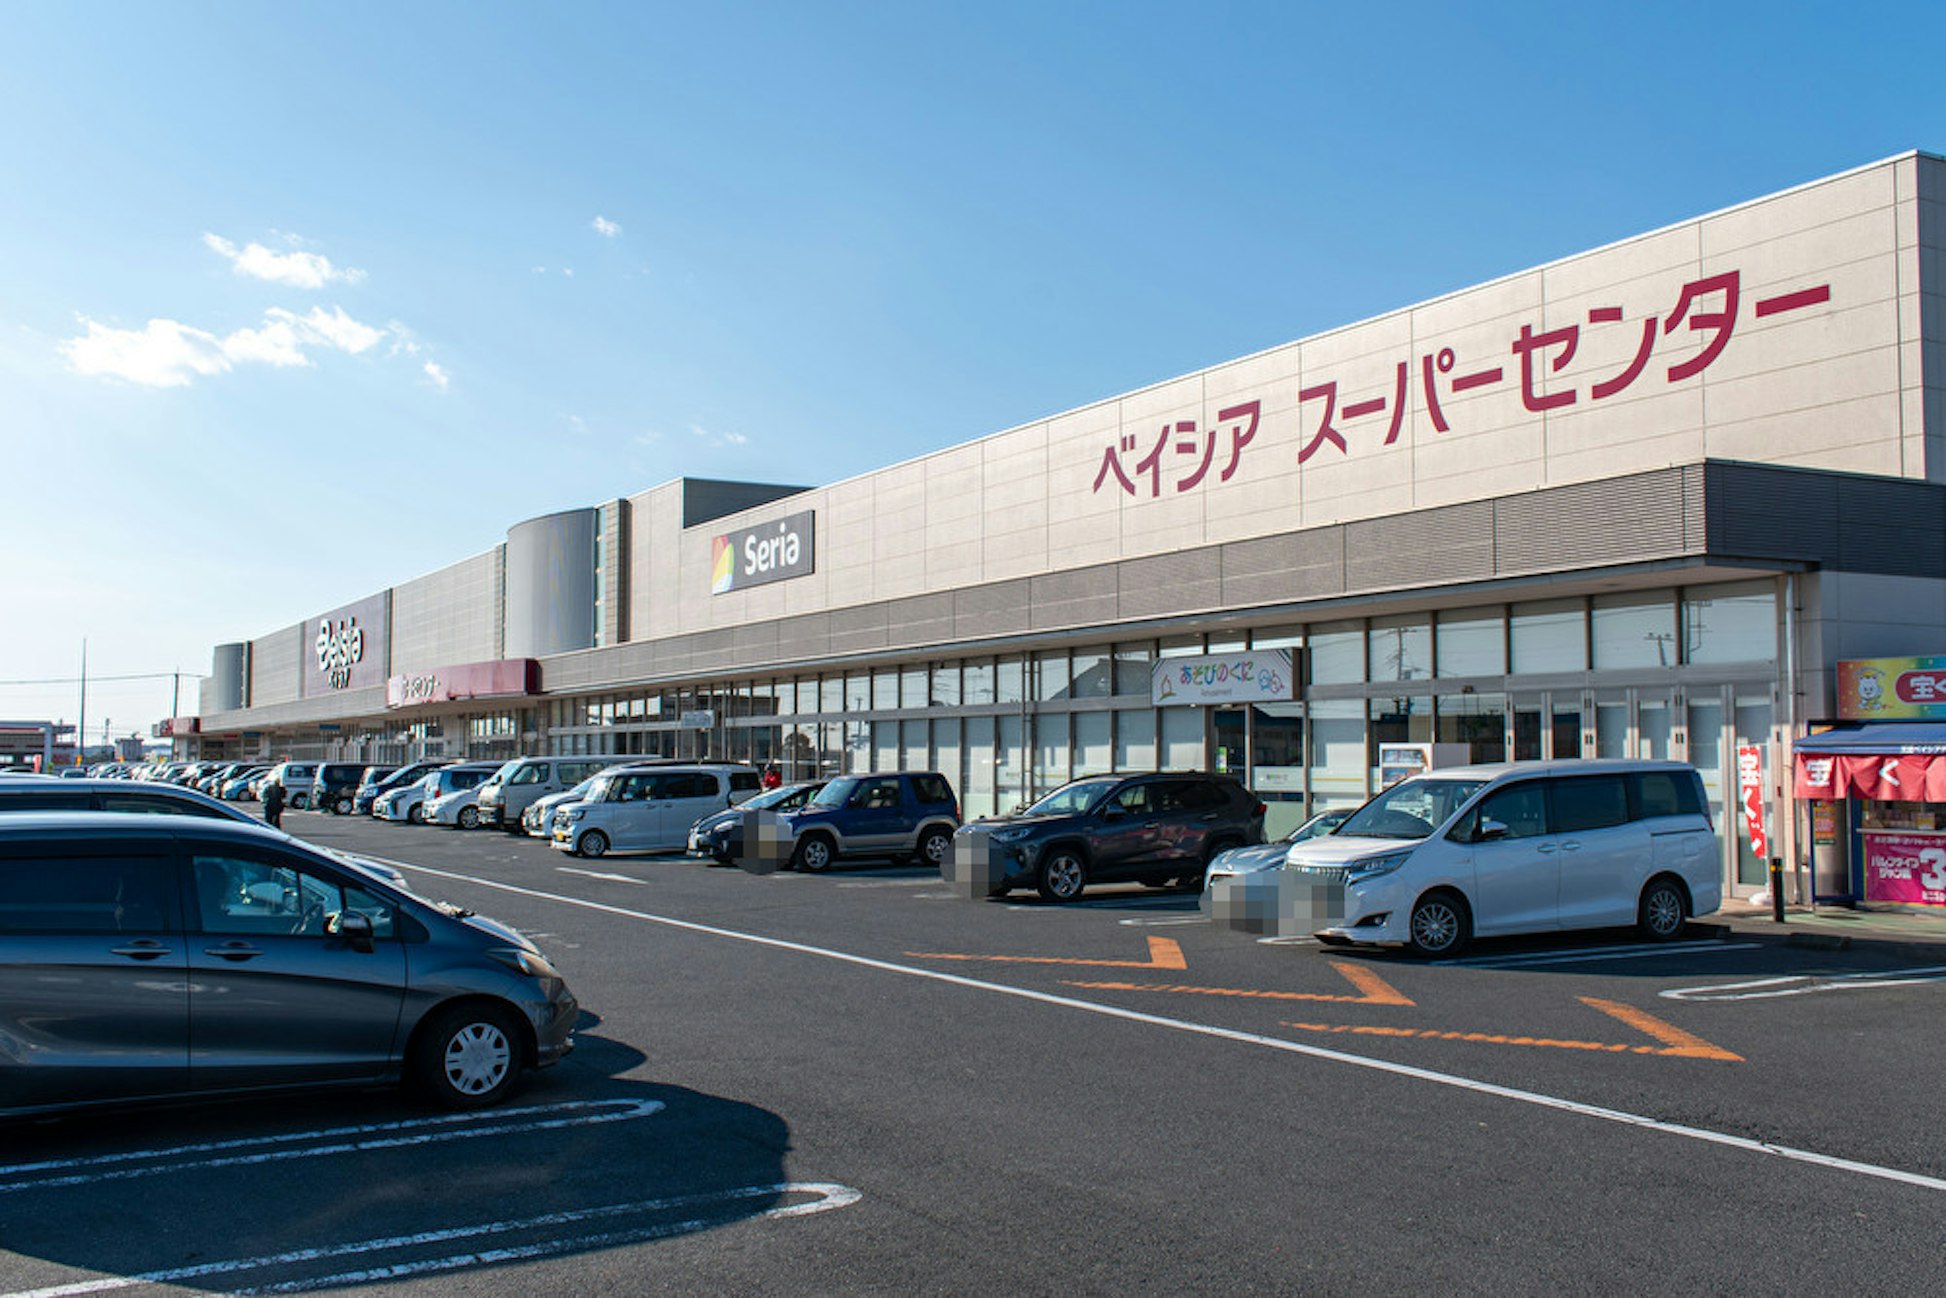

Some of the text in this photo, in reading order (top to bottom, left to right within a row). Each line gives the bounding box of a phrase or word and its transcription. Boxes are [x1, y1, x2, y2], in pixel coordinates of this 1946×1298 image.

[1093, 269, 1830, 498] ベイシア スーパーセンター
[744, 521, 800, 576] Seria
[1180, 660, 1254, 686] あそびのくに
